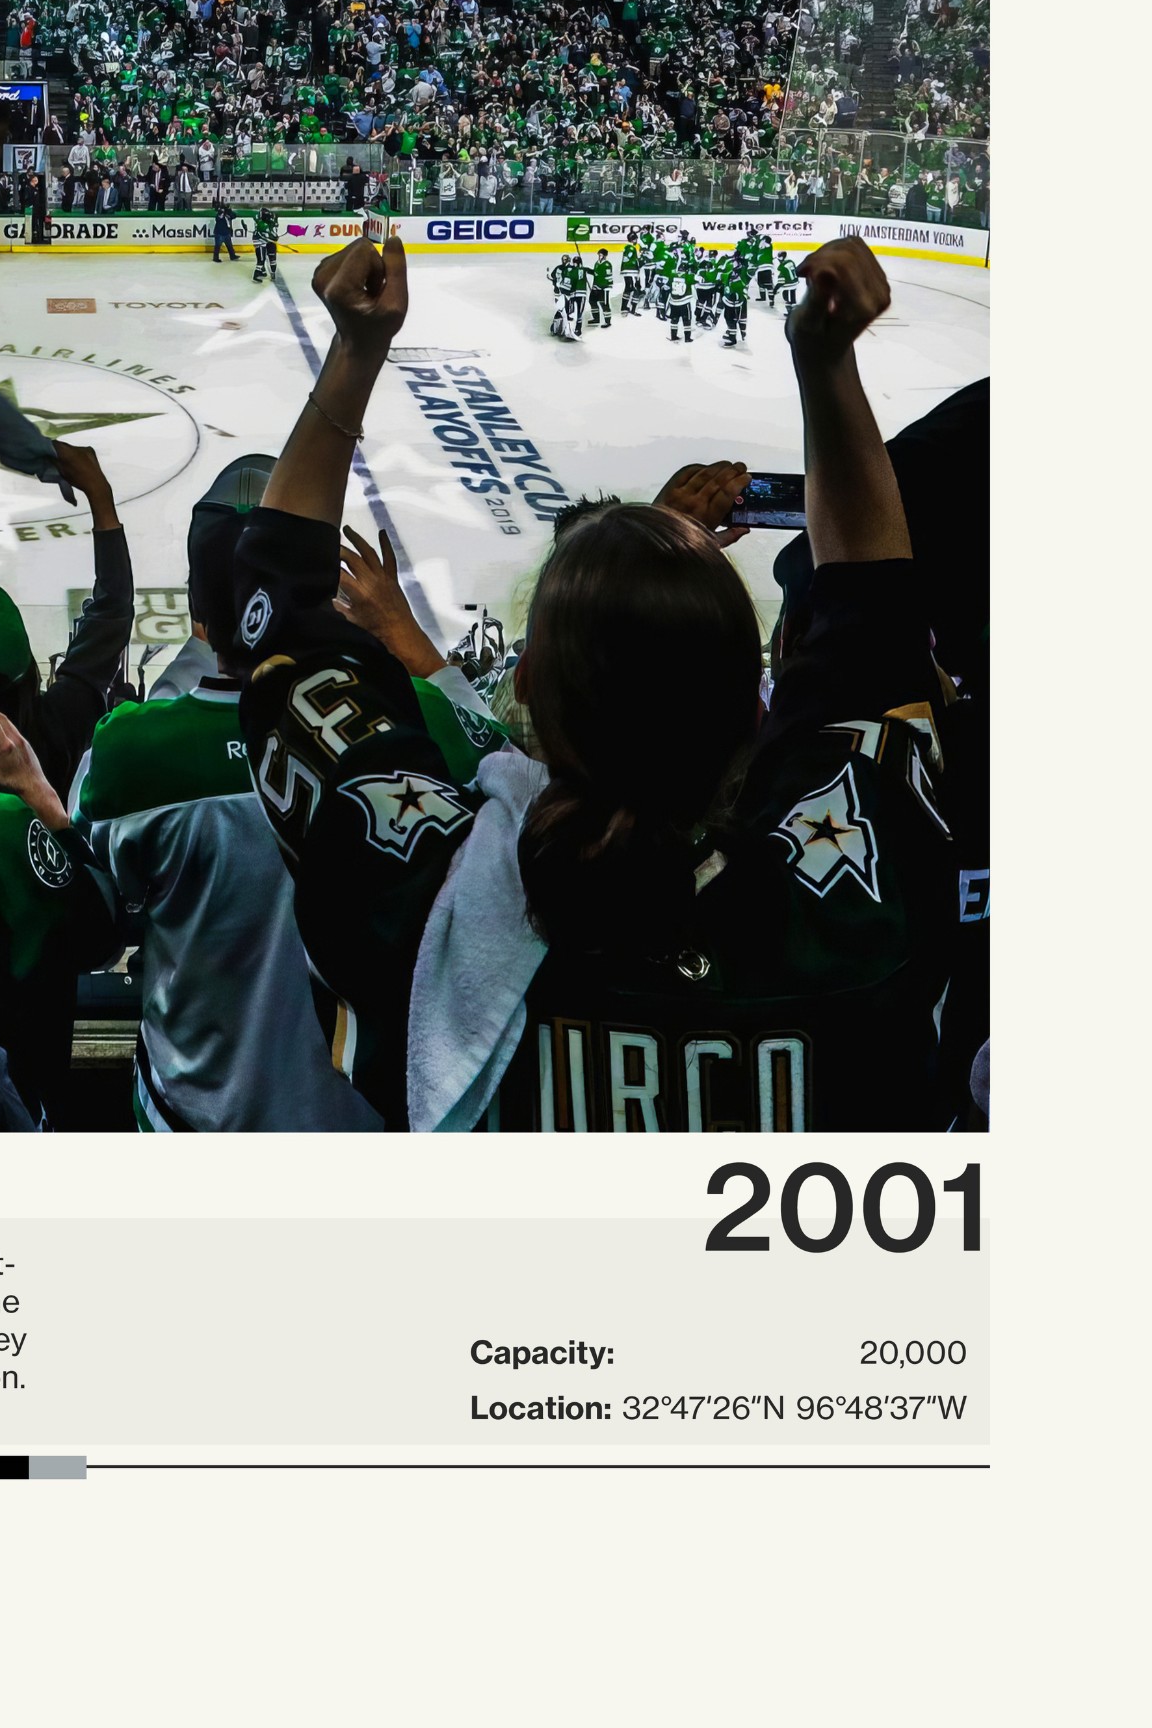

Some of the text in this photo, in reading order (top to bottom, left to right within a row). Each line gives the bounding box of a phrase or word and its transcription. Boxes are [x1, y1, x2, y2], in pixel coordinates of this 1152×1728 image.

[152, 223, 247, 239] MassMual
[427, 219, 535, 240] GEICO
[701, 220, 814, 232] WeatherTech
[862, 223, 930, 244] AMSTERDAM
[108, 301, 225, 310] TOYOTA
[443, 364, 552, 474] STANLEY
[398, 365, 522, 536] PLAYOFFS 2019
